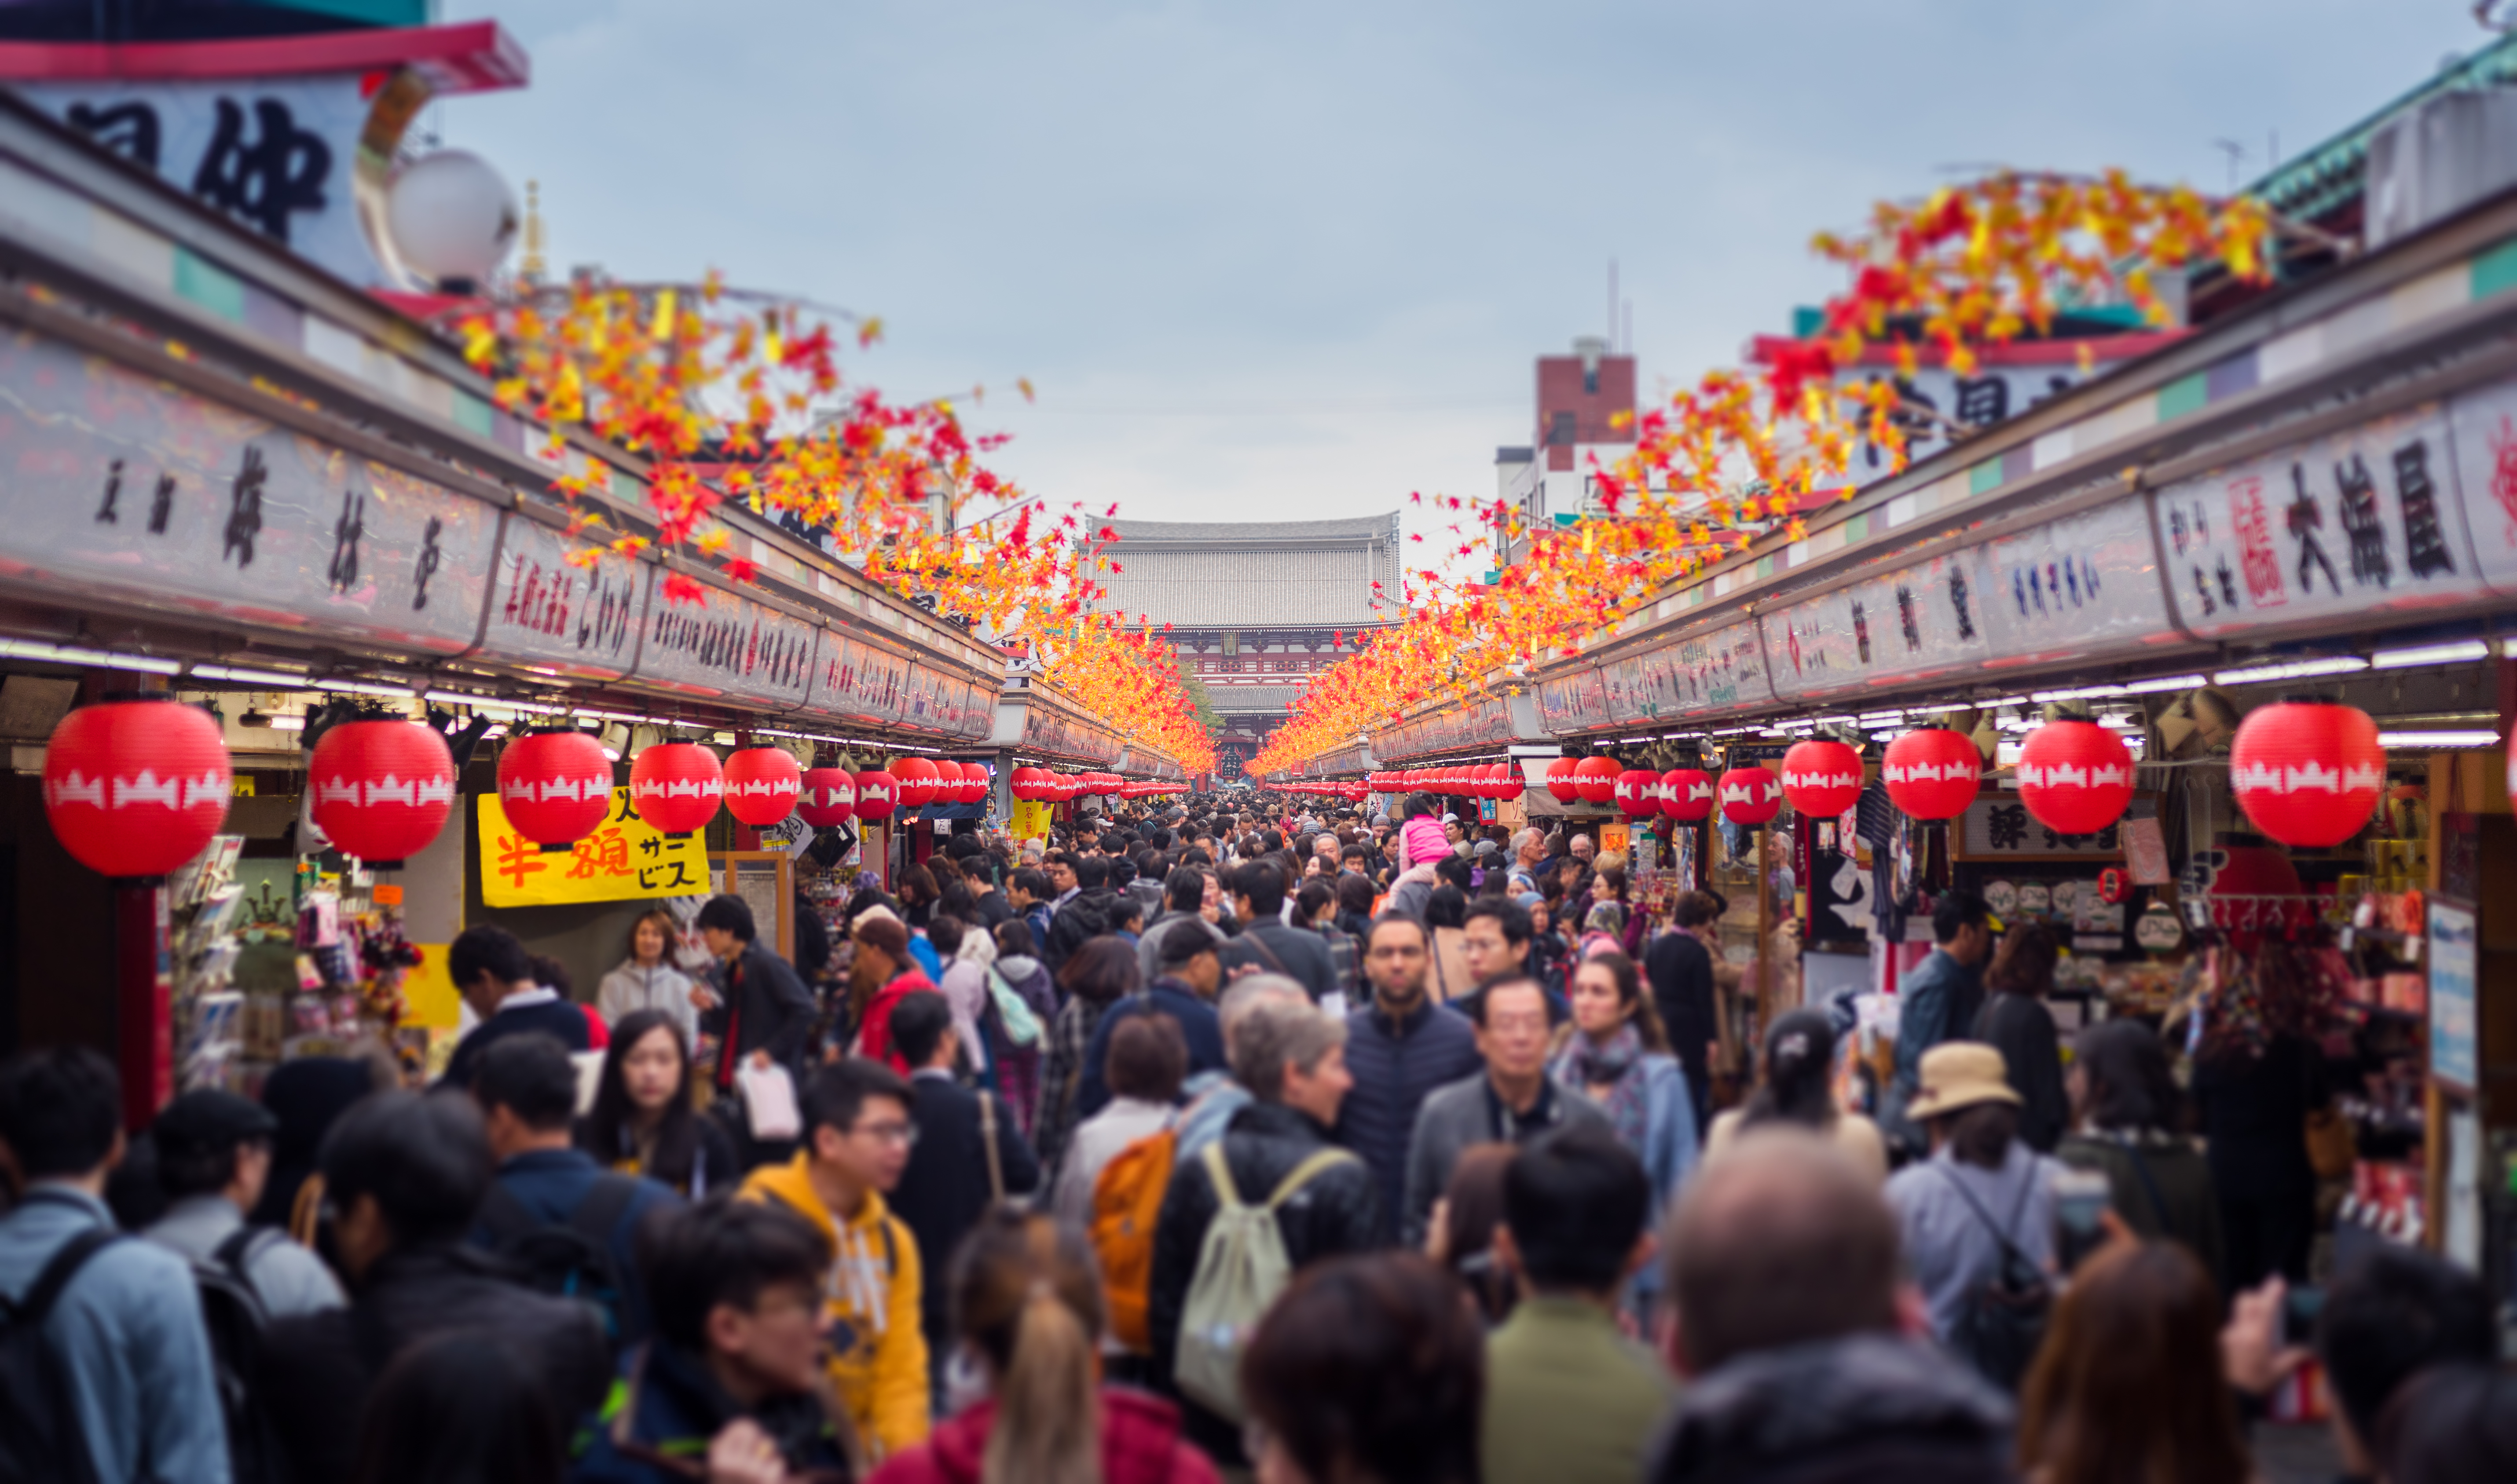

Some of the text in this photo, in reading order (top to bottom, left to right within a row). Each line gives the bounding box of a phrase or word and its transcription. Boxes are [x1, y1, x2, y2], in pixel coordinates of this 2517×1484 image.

[1024, 807, 1033, 835] 名菓
[497, 827, 635, 888] 半額
[639, 836, 685, 859] サー
[639, 861, 696, 890] ビス
